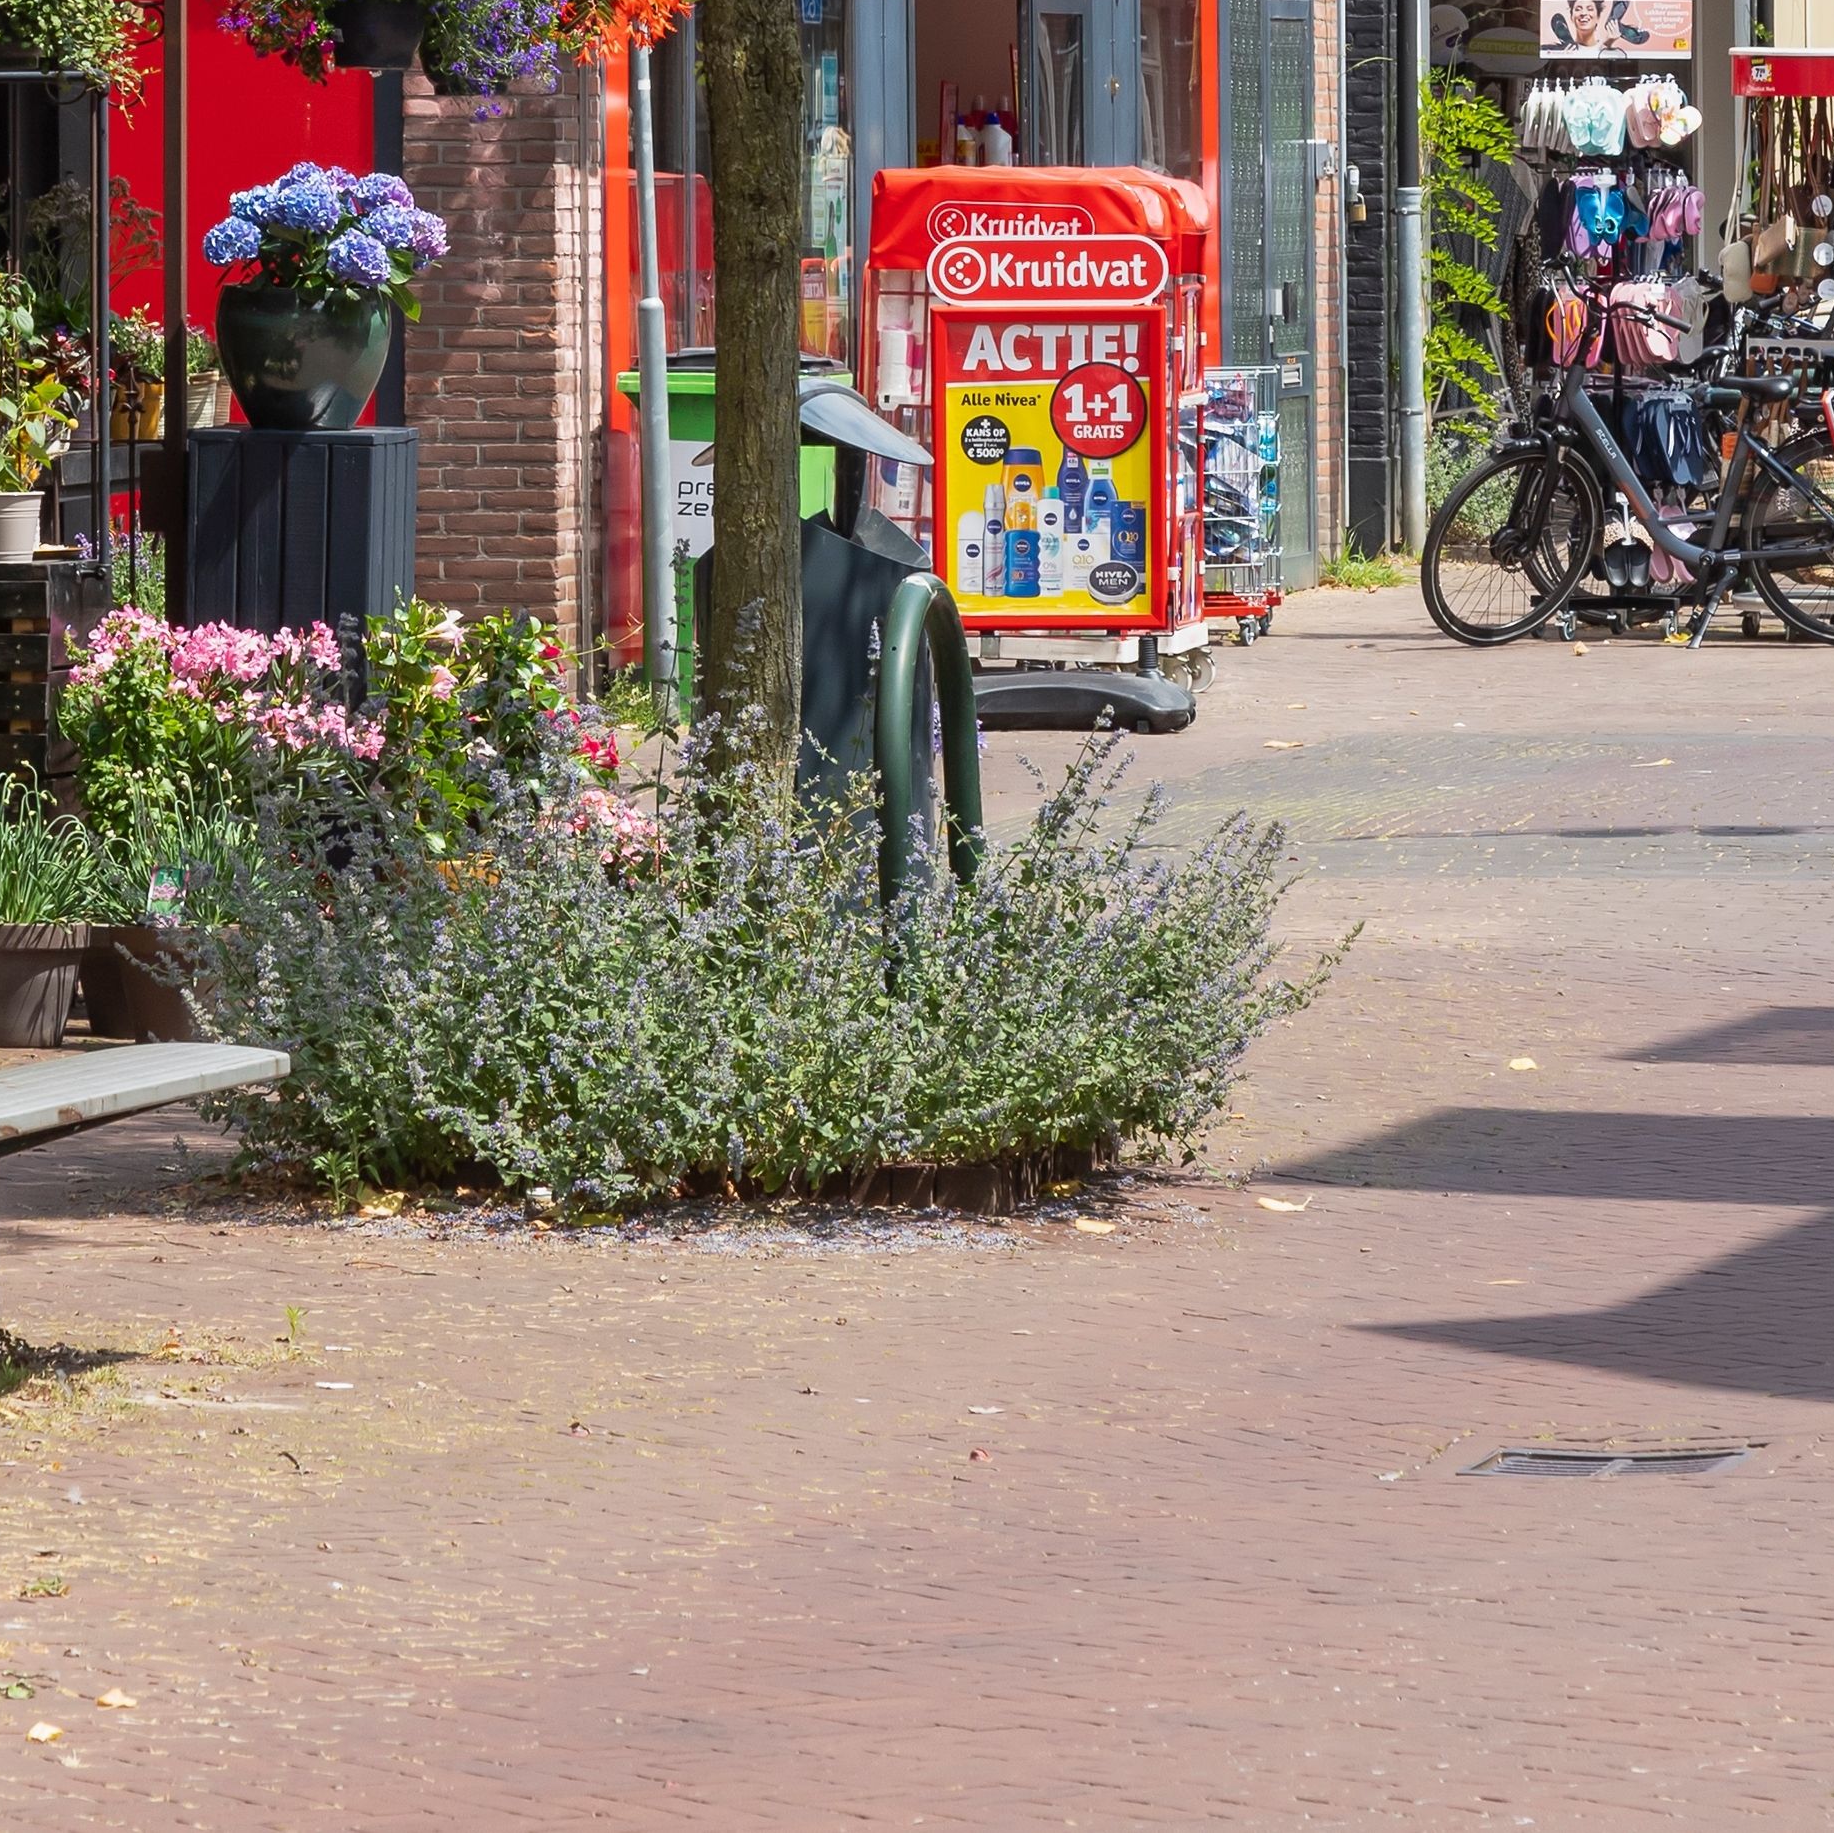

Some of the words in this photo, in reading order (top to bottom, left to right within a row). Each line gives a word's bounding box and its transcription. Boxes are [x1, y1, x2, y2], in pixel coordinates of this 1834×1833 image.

[969, 212, 1082, 236] Kruidvat
[989, 250, 1148, 288] Kruidvat
[962, 323, 1140, 372] ACTIE!
[961, 393, 991, 406] Alle
[1063, 382, 1133, 422] 1+1
[965, 428, 992, 437] KANS
[993, 428, 1006, 437] OP
[1073, 424, 1125, 439] GRATIS
[677, 501, 714, 517] ze
[1118, 530, 1139, 543] Q10
[1095, 570, 1132, 579] NIVEA
[1098, 578, 1128, 586] MEN
